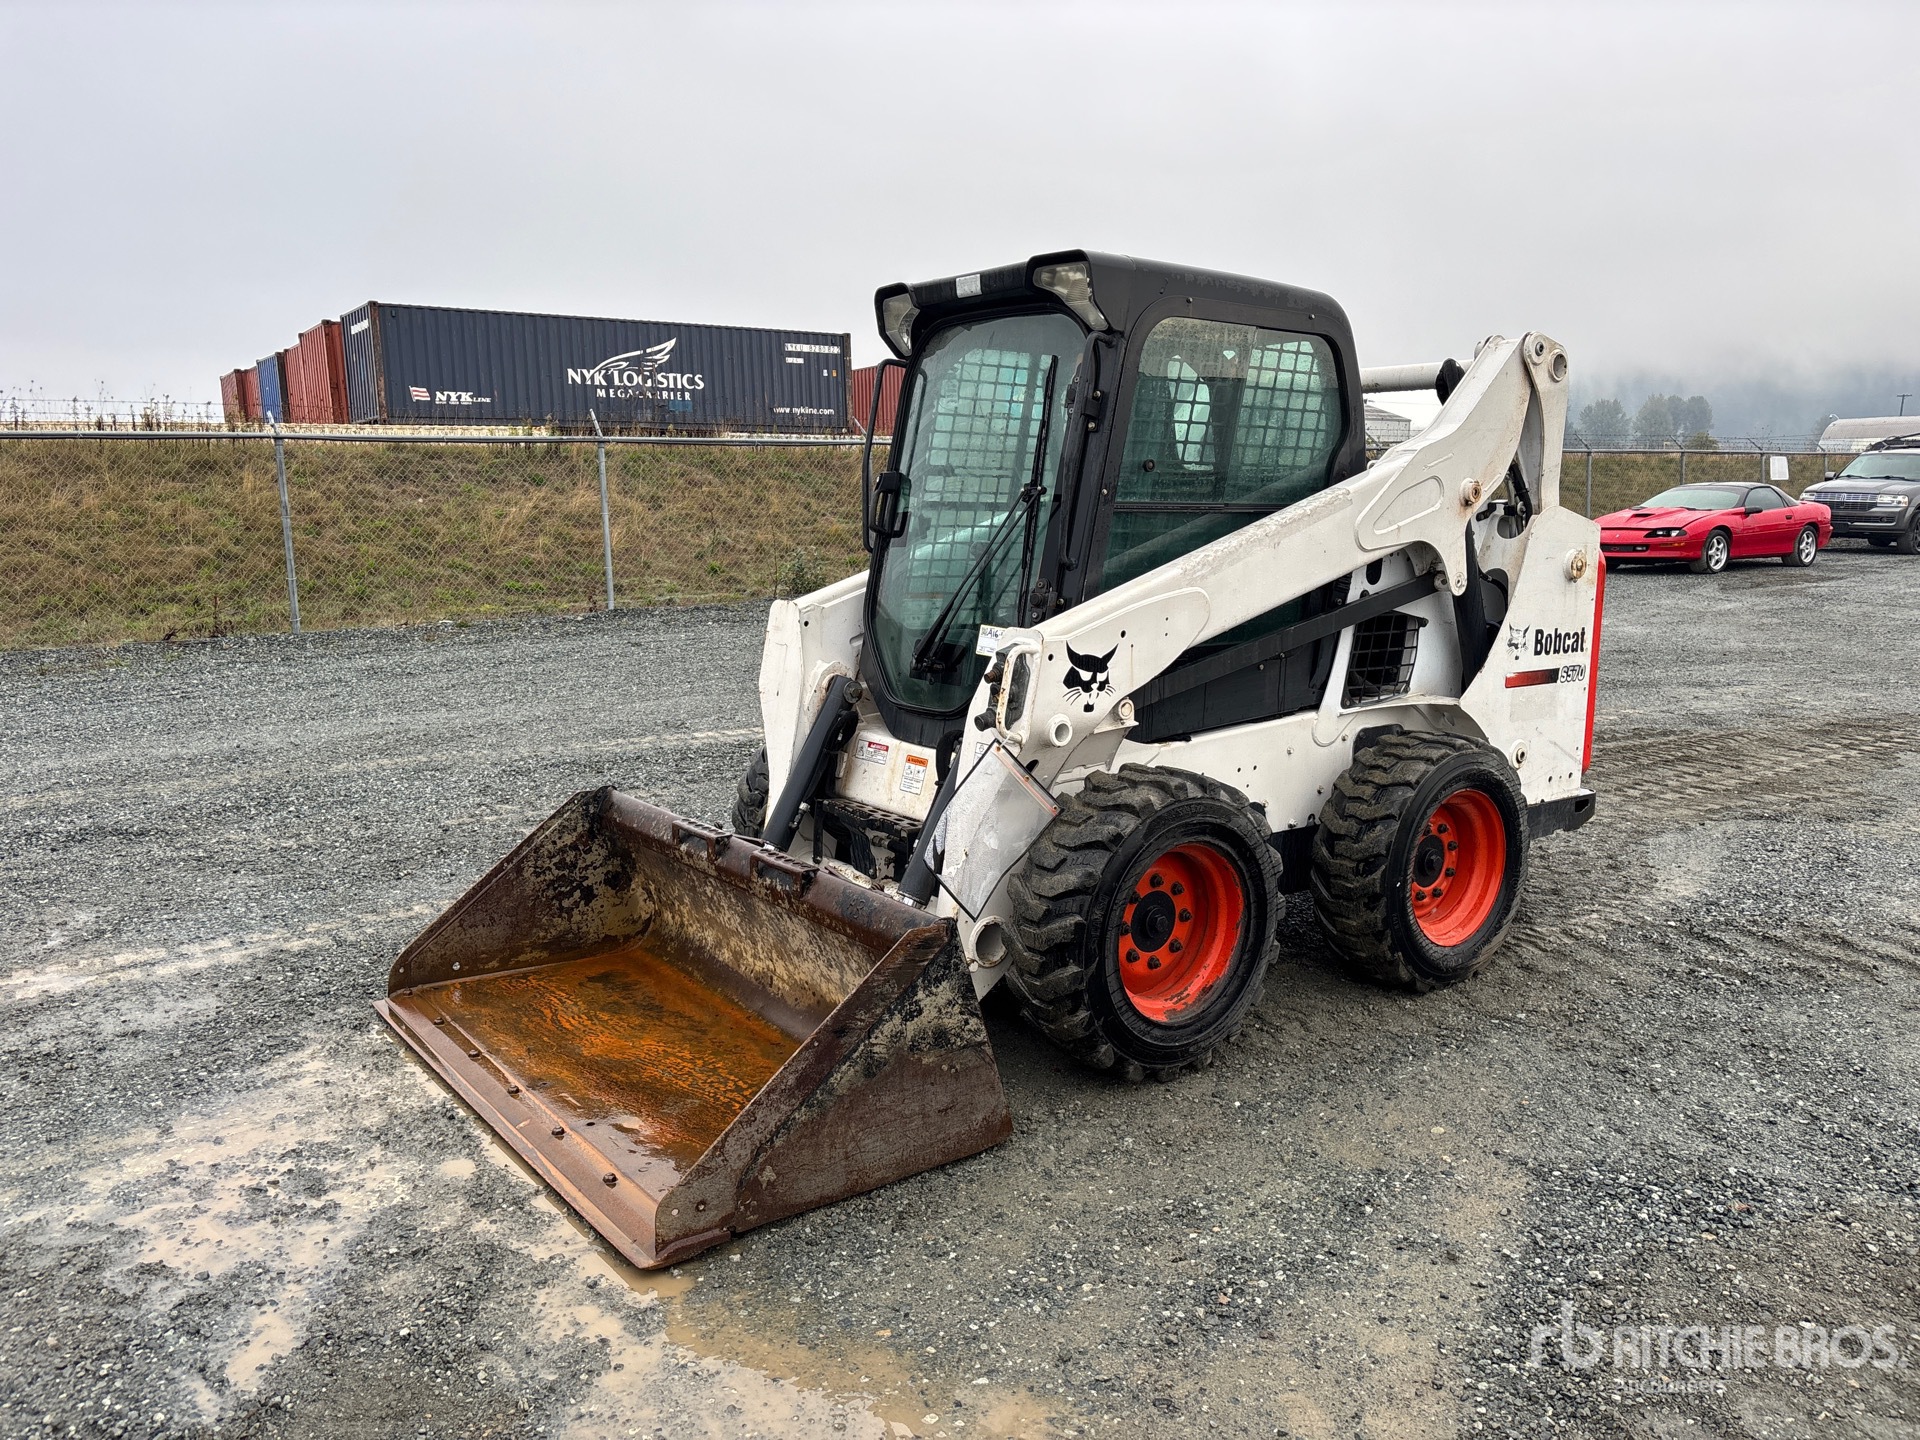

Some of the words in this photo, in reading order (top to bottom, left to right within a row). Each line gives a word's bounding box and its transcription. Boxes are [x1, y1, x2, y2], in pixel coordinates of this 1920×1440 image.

[567, 368, 607, 386] NYK
[613, 370, 704, 390] LOGISTICS
[435, 391, 473, 402] NYK
[1534, 627, 1585, 656] Bobcat
[1560, 664, 1586, 683] S570
